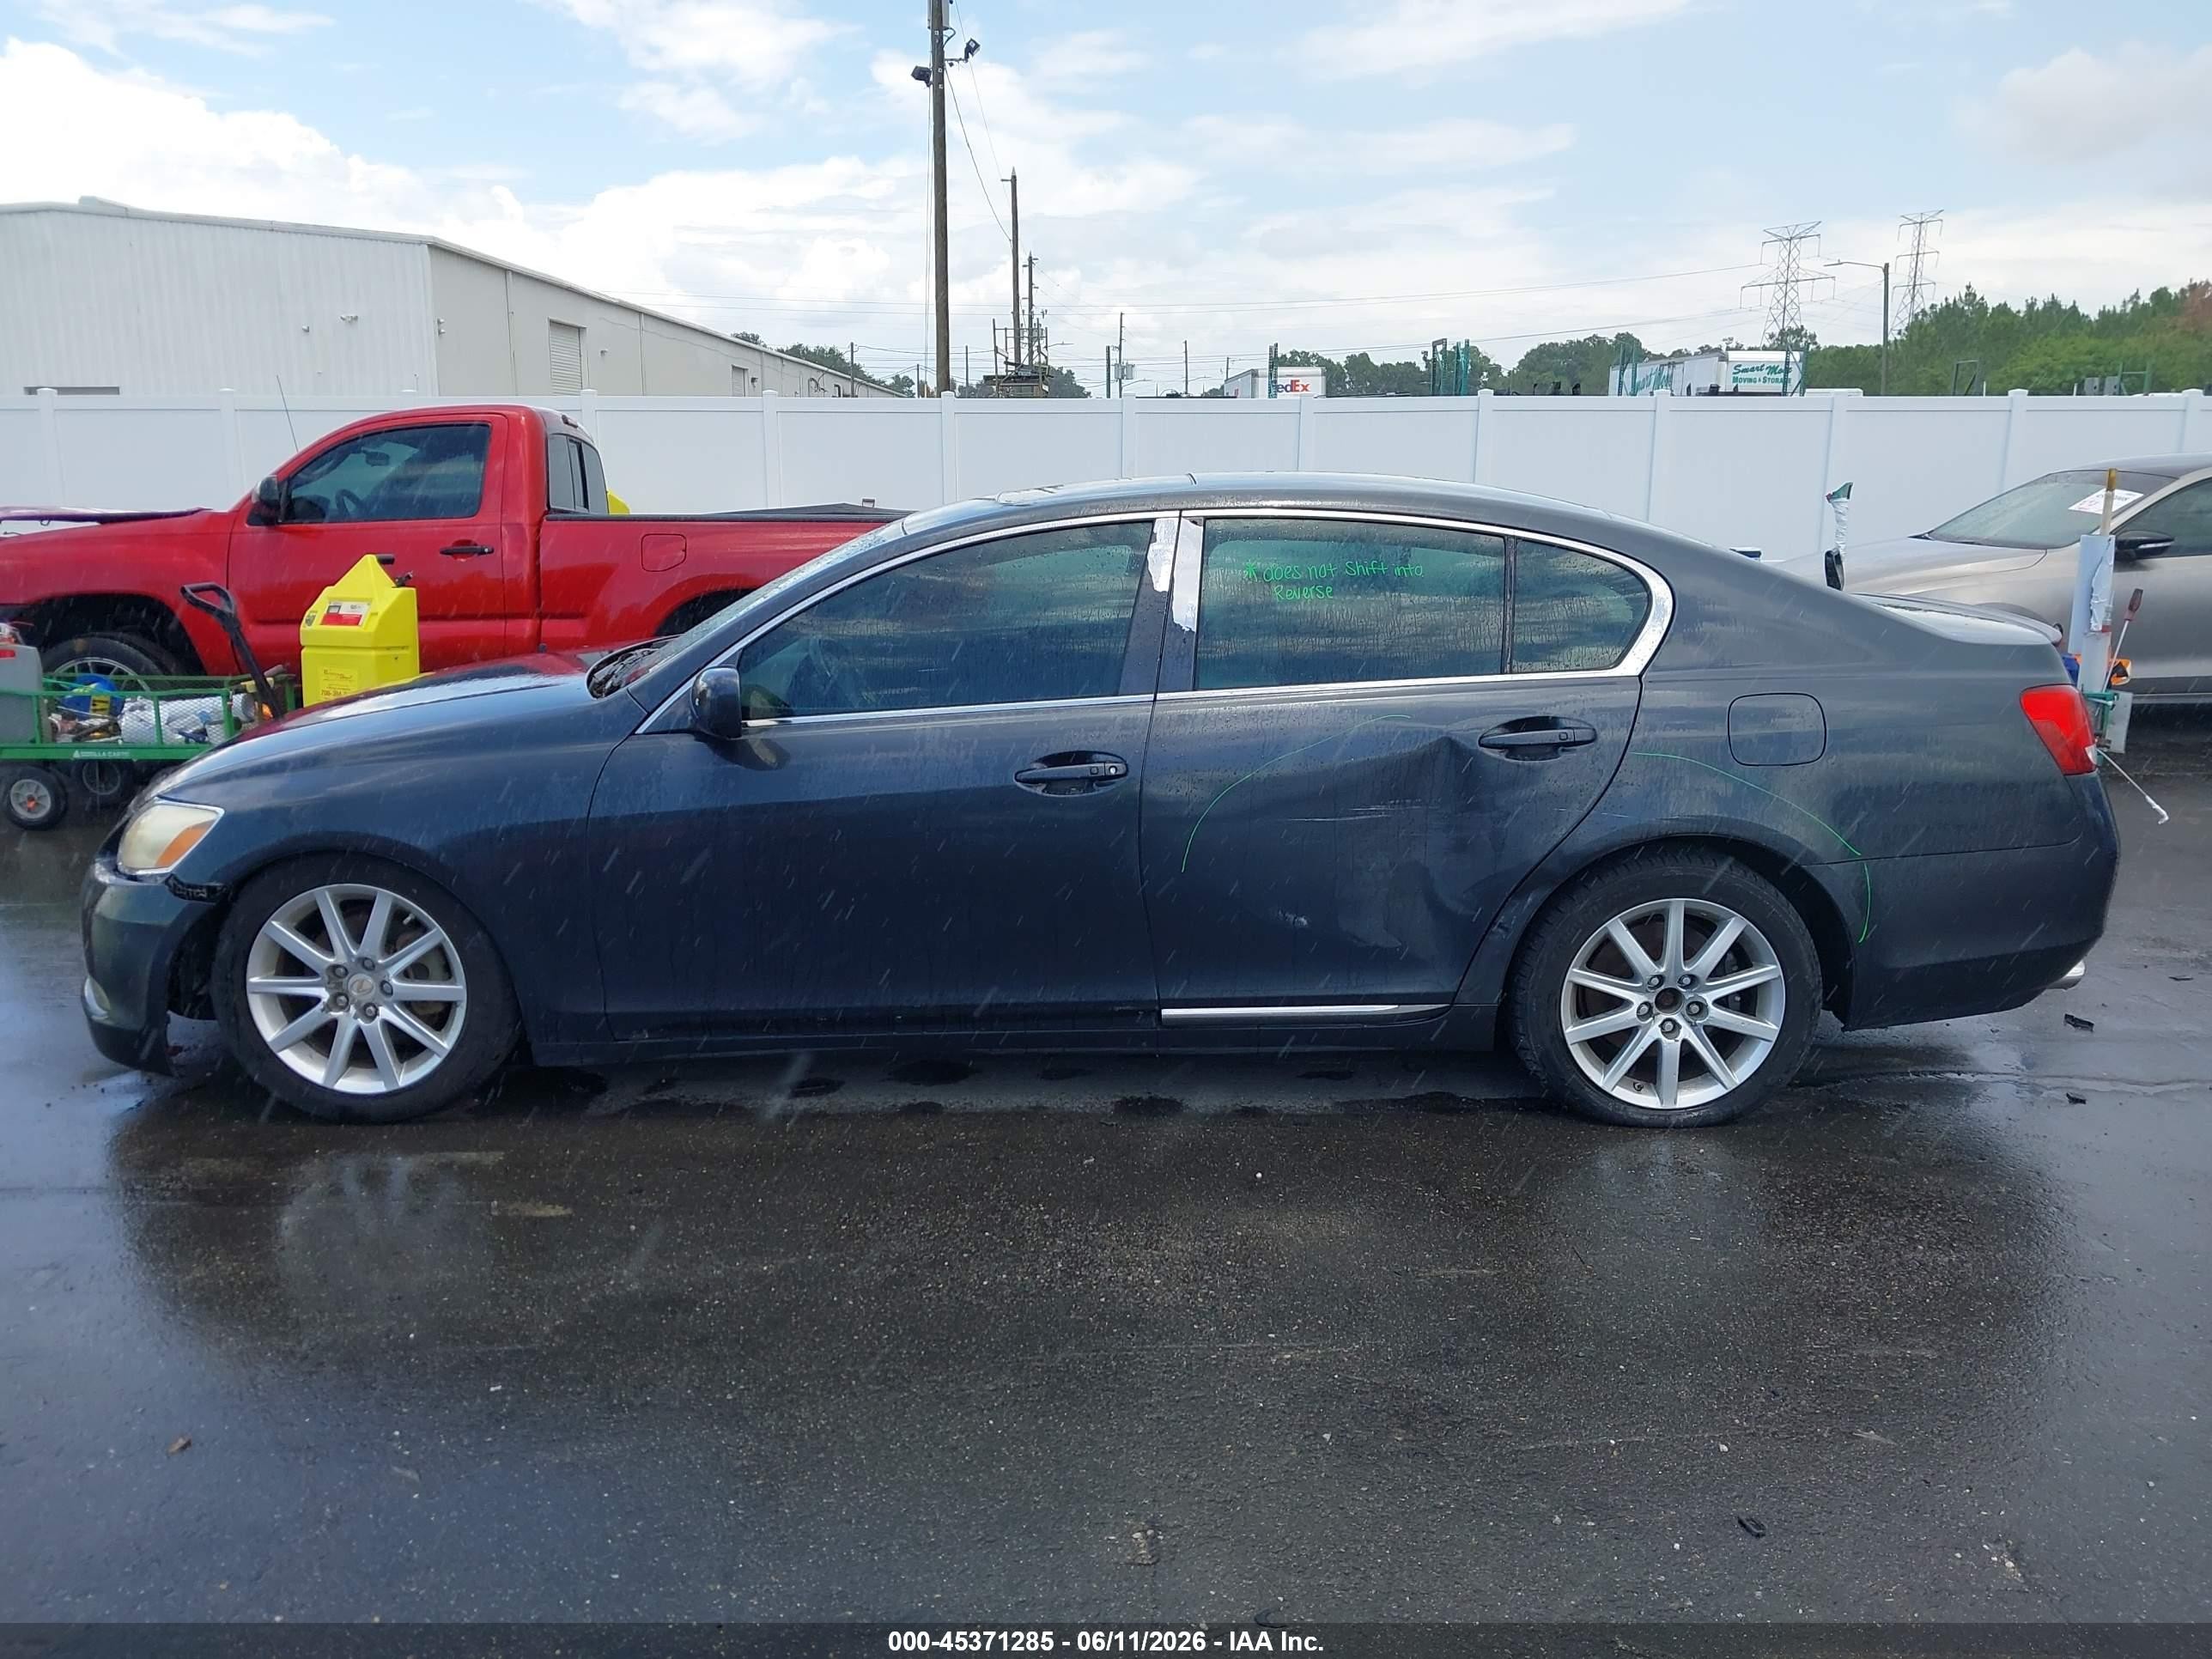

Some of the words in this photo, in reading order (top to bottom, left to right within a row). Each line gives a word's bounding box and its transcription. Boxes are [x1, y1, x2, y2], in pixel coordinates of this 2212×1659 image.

[1732, 364, 1765, 375] Smart
[1765, 364, 1793, 375] Moe
[1275, 380, 1310, 392] edEx
[1263, 563, 1302, 582] does
[1308, 562, 1338, 581] not
